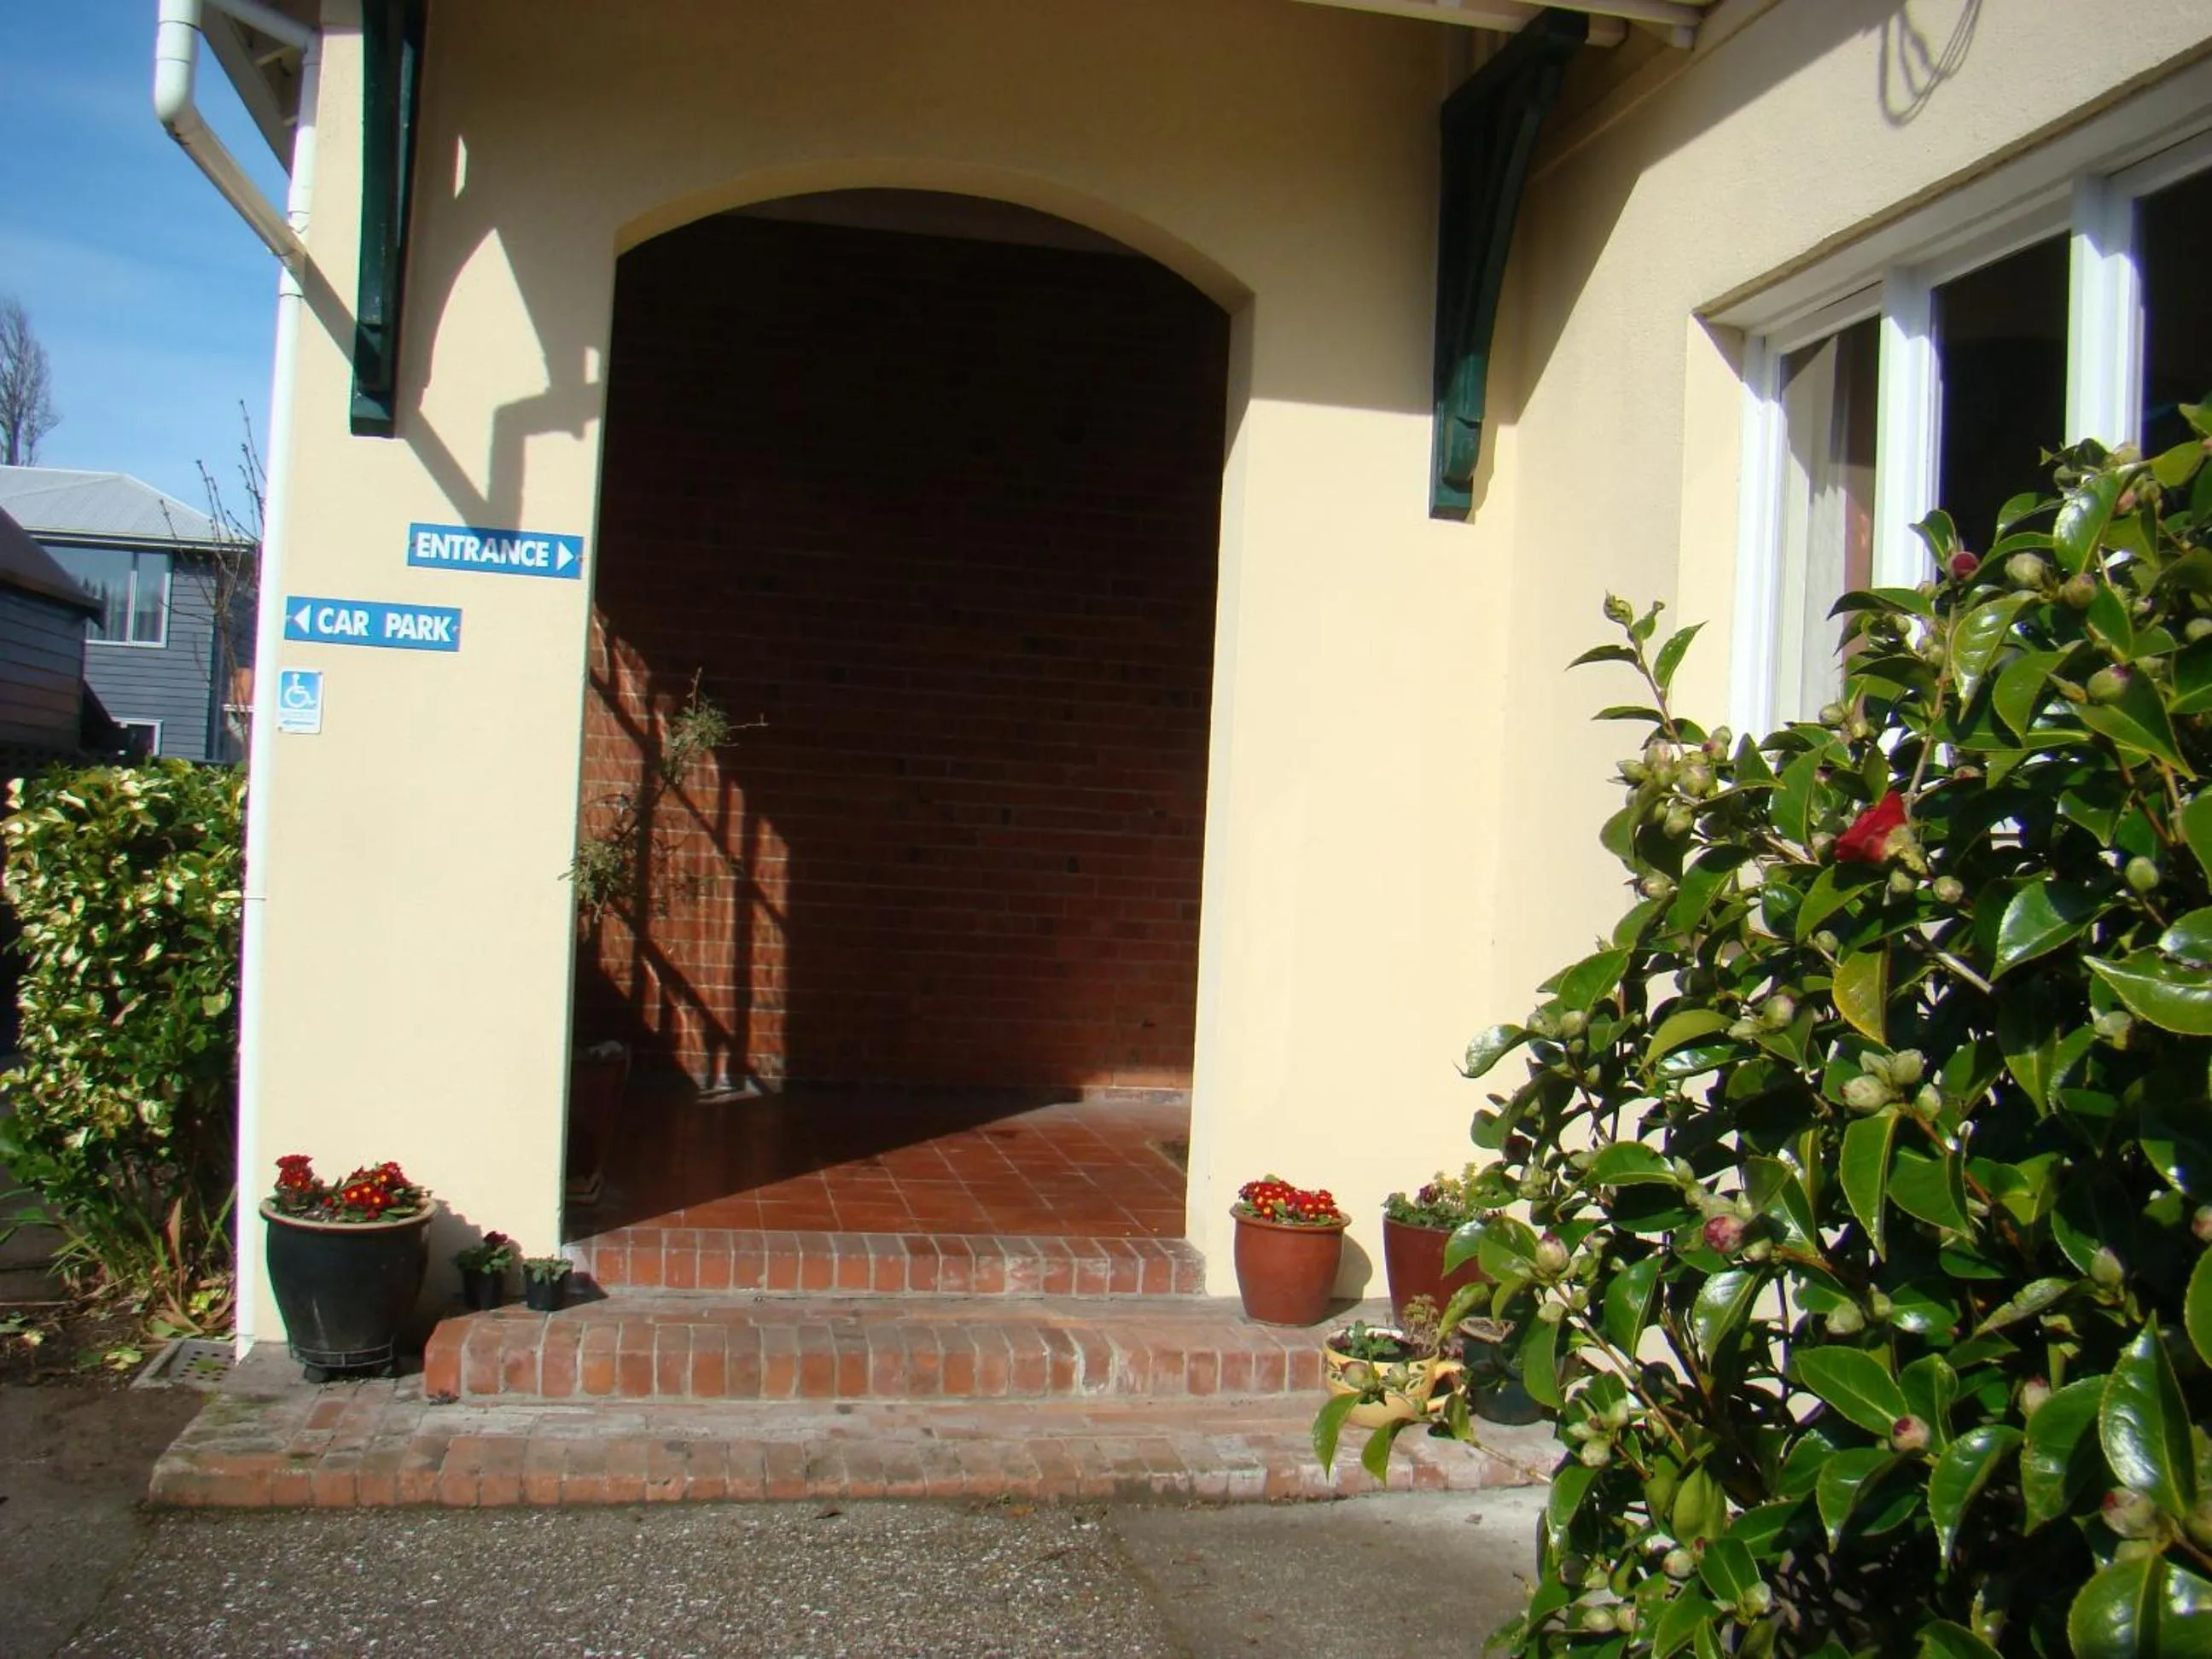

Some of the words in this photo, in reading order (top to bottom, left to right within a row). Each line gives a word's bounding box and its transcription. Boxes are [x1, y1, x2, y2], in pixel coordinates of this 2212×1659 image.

[416, 533, 550, 568] ENTRANCE
[317, 608, 370, 637] CAR
[385, 613, 452, 642] PARK
